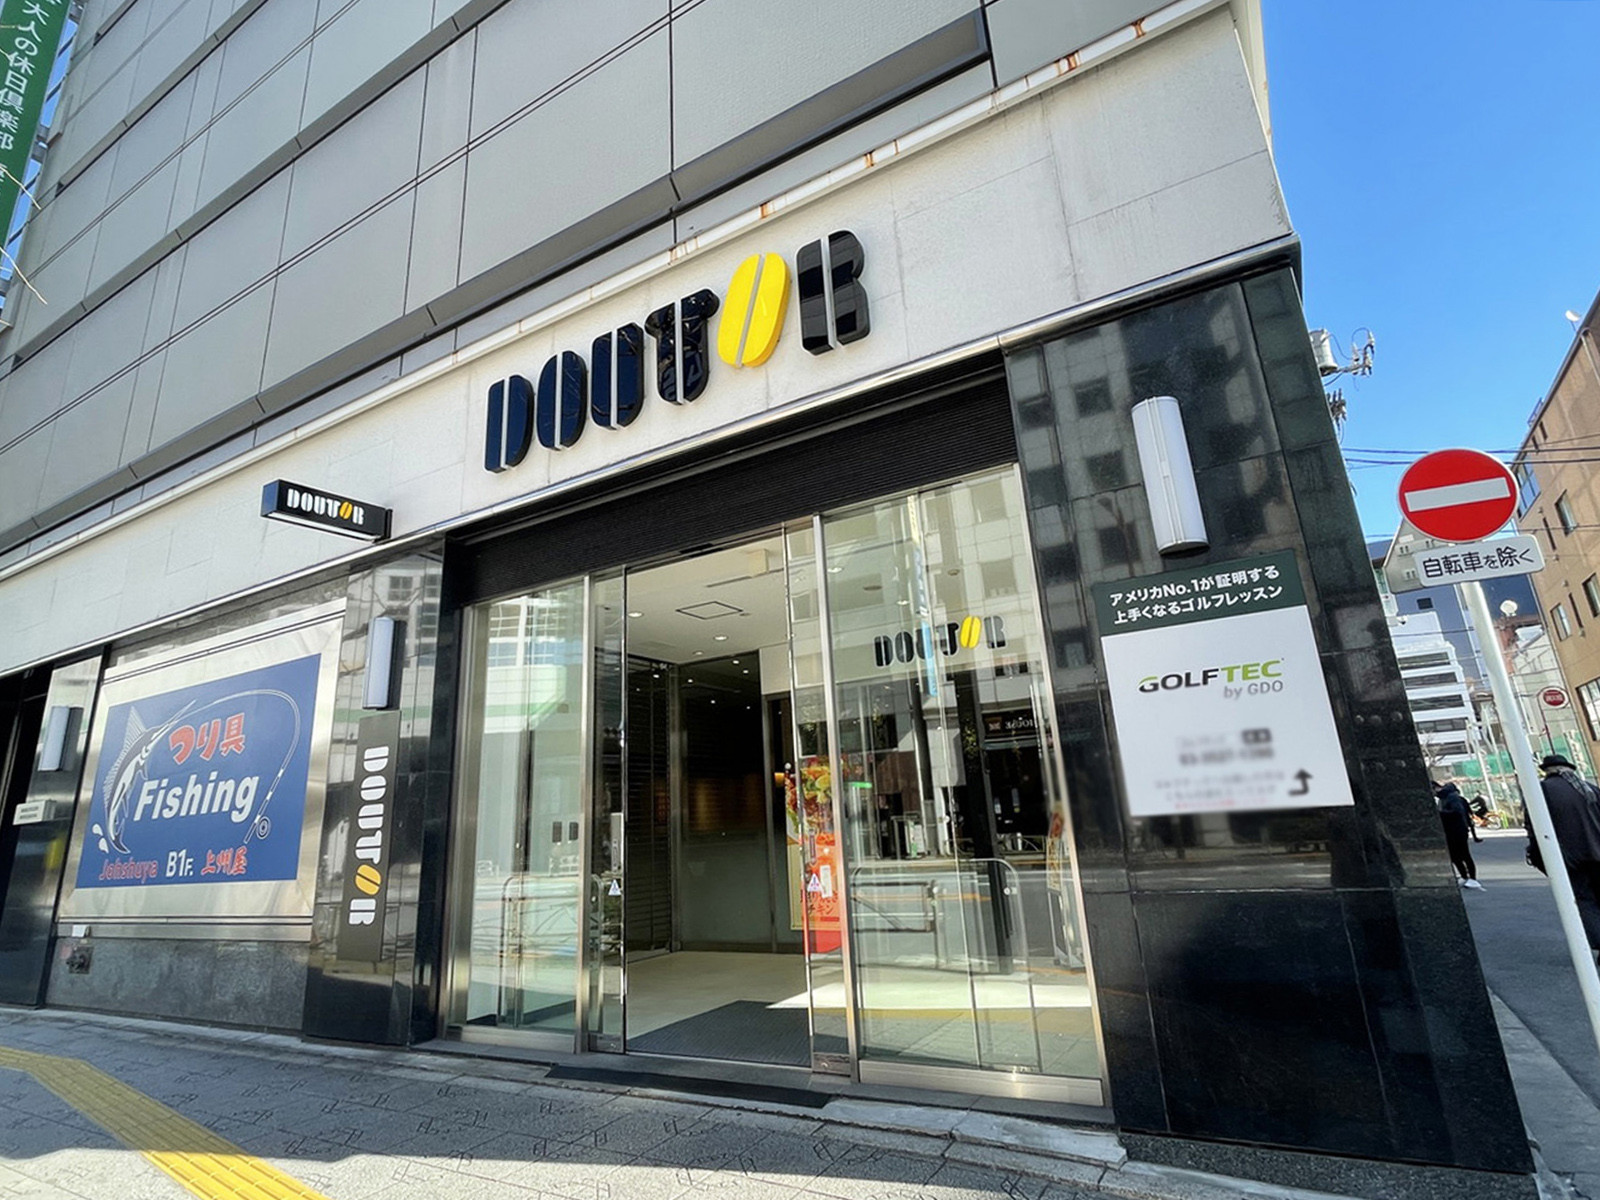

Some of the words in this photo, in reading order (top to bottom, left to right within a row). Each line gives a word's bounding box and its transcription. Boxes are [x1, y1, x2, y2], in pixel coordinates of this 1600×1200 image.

[484, 229, 872, 474] DOUTOR
[286, 488, 365, 525] DOUTOR
[1422, 545, 1535, 579] 自転車を除く
[1109, 564, 1281, 608] アメリカNo.1が証明する
[1113, 584, 1284, 626] 上手くなるゴルフレッスン
[1138, 659, 1283, 694] GOLFTEC
[1223, 685, 1243, 701] by
[1247, 680, 1284, 696] GDO
[168, 712, 246, 766] つり具
[133, 770, 260, 824] Fishing
[348, 746, 390, 926] DOUTOR
[200, 845, 248, 876] 上州屋
